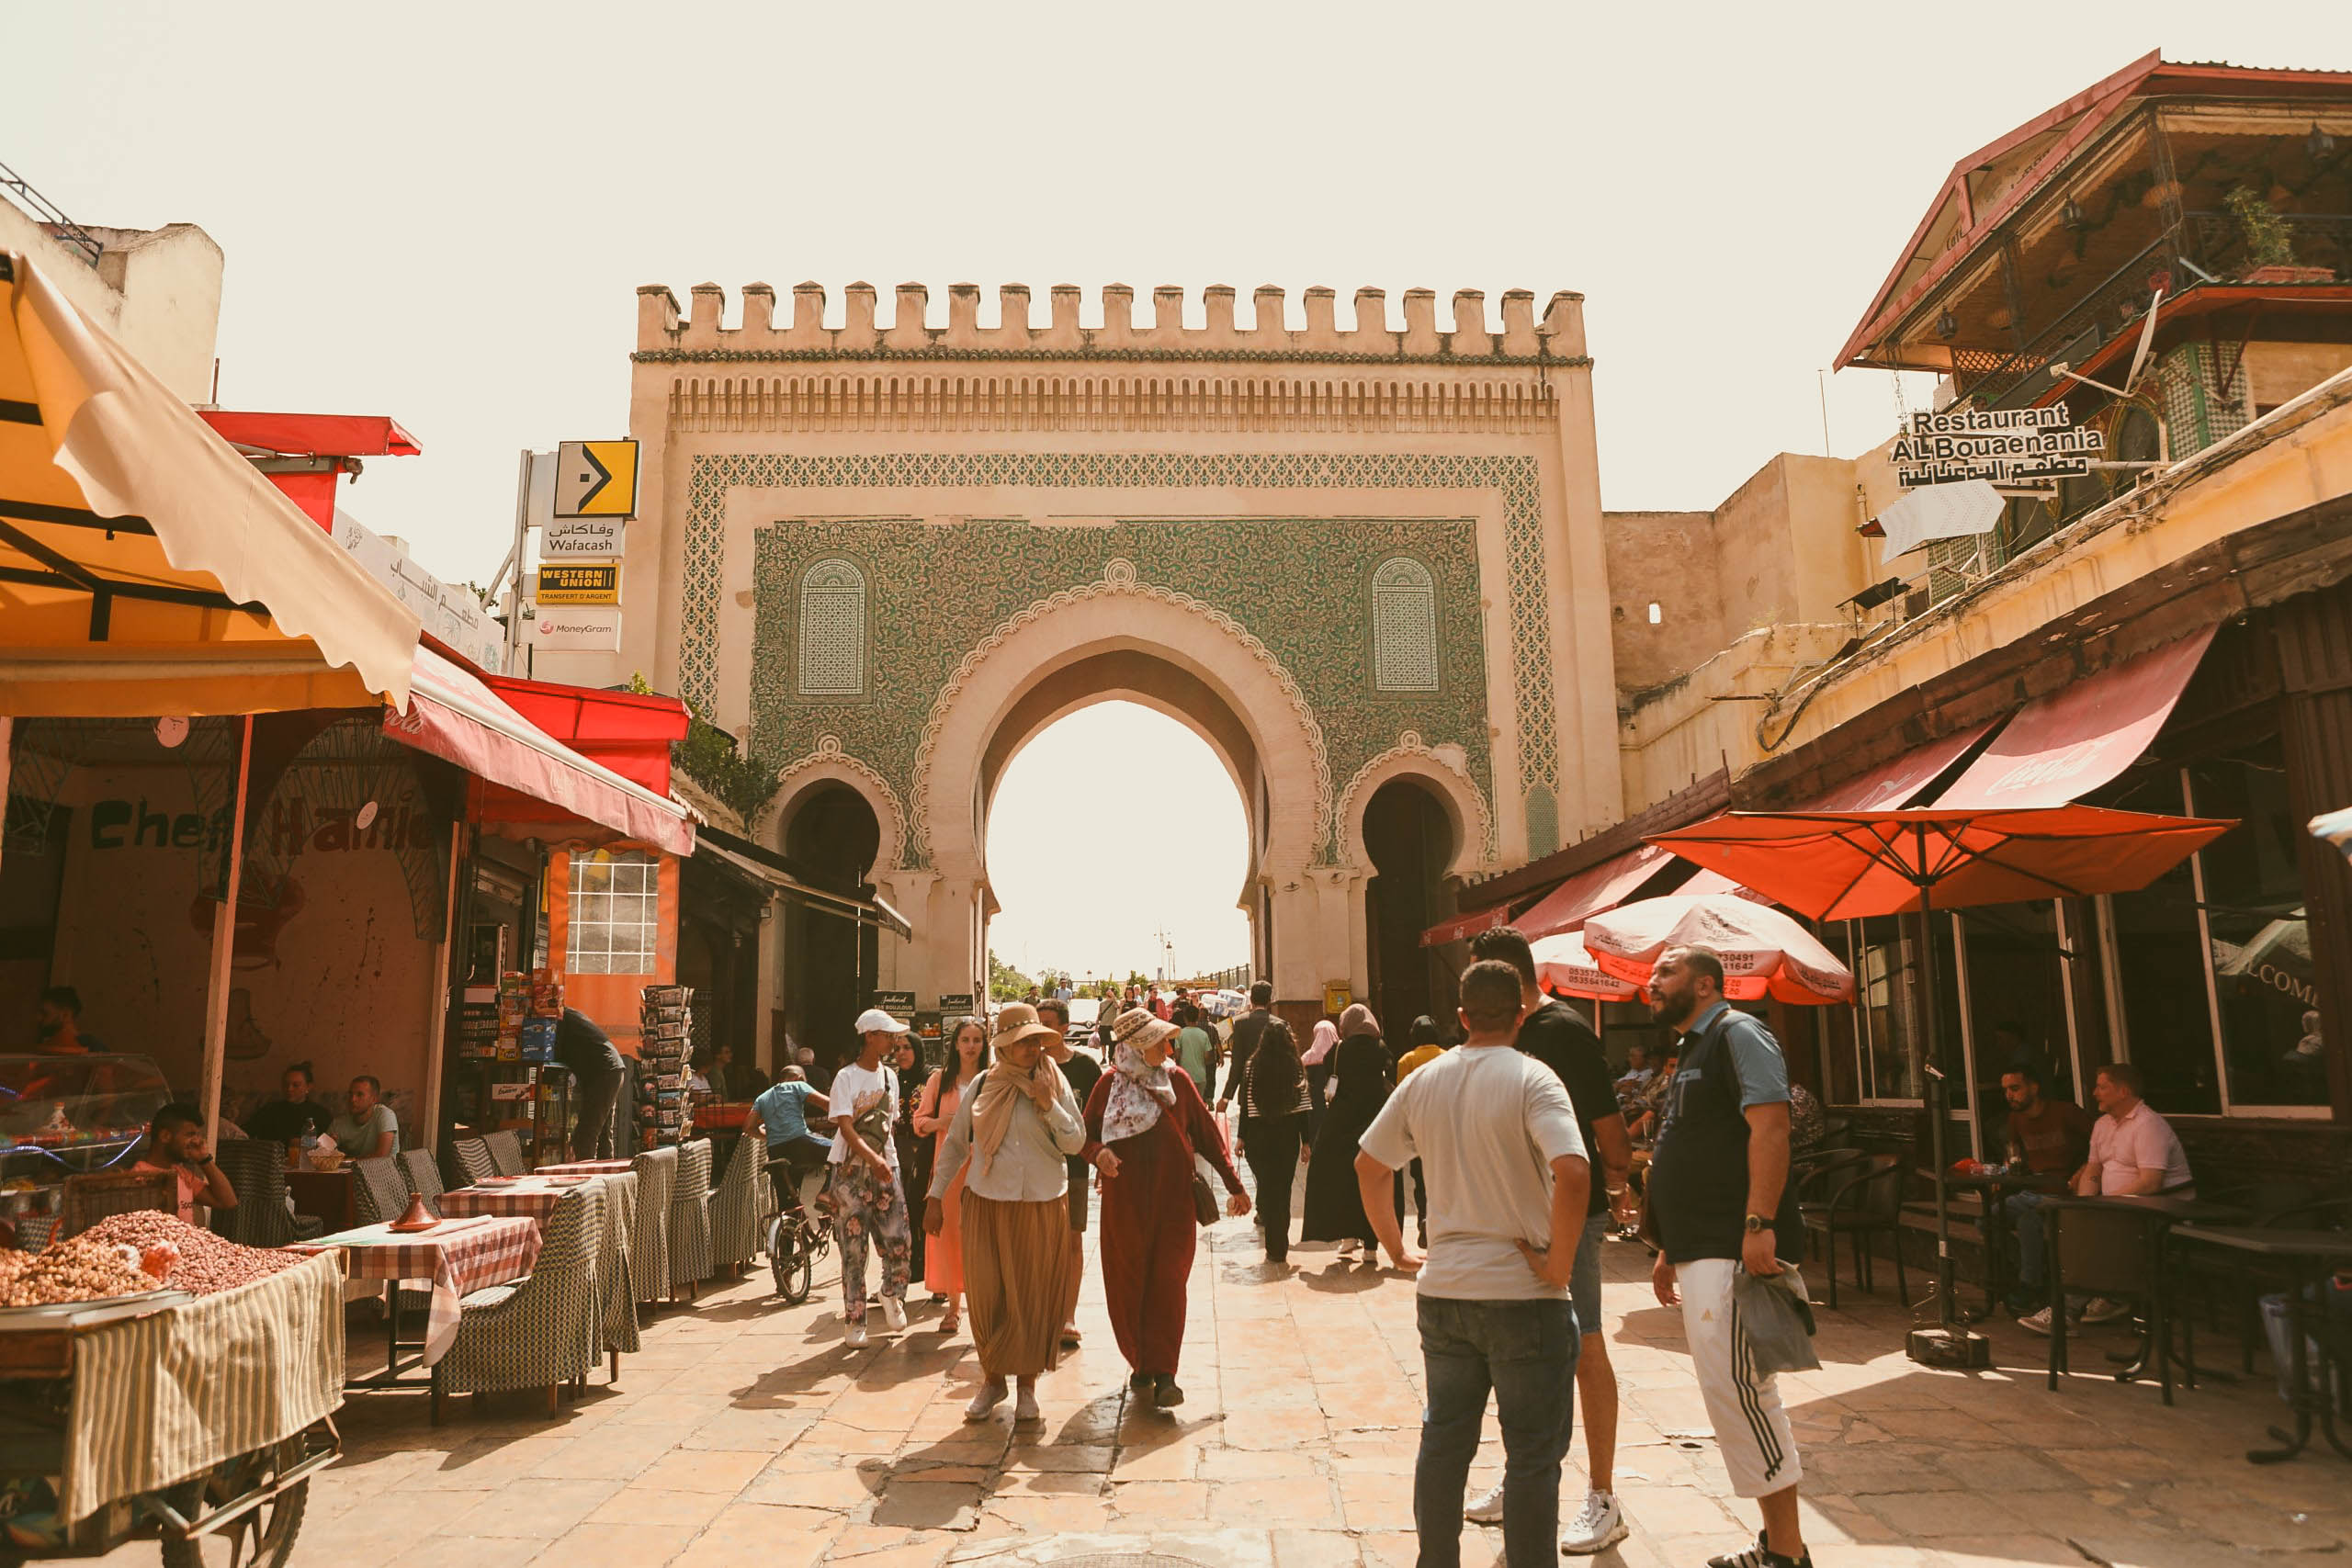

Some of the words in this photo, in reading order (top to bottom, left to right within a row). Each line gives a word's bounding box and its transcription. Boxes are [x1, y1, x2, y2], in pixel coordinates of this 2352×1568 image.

[1914, 404, 2068, 434] Restaurant
[2012, 457, 2087, 483] مطعم
[548, 523, 614, 537] وفاكاش
[548, 539, 613, 551] Wafacash
[390, 558, 438, 602] الشباب
[542, 570, 603, 579] WESTERN
[560, 579, 603, 587] UNION
[438, 592, 479, 630] مطعم
[555, 625, 612, 635] MoneyGram
[1717, 953, 1754, 962] 730491
